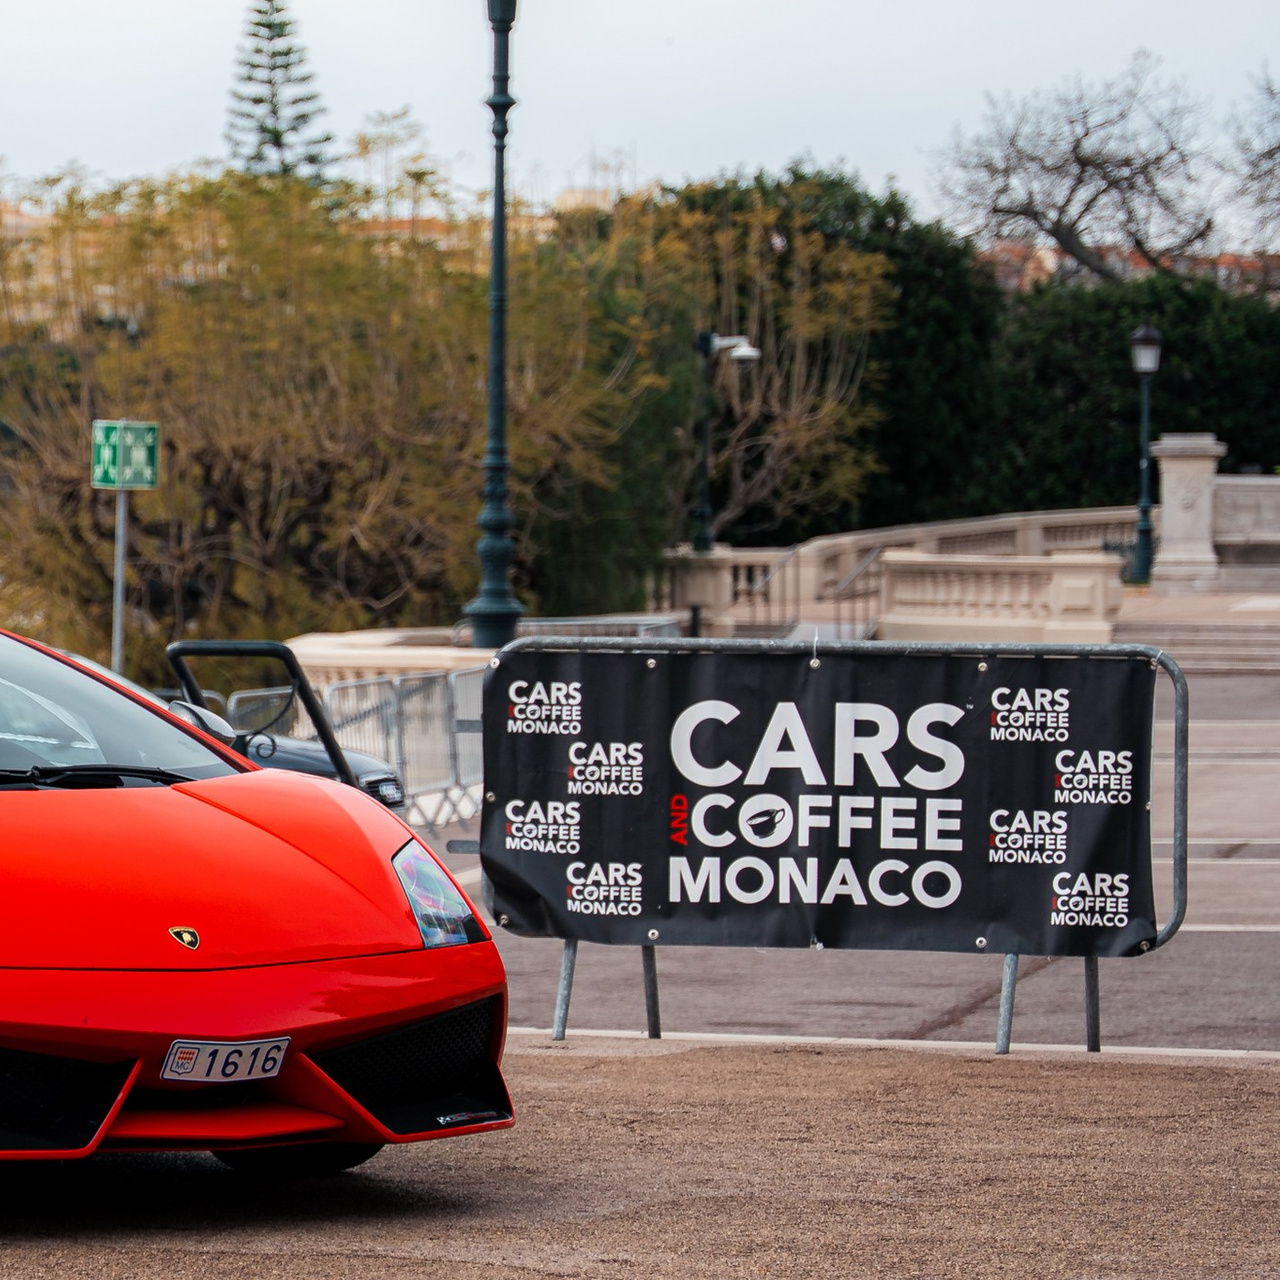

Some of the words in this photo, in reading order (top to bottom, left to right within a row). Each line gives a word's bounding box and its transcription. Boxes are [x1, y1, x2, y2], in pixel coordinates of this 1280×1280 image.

[508, 680, 582, 705] CARS
[991, 687, 1070, 711] CARS
[514, 705, 582, 720] COFFEE
[996, 711, 1069, 727] COFFEE
[507, 719, 581, 734] MONACO
[990, 727, 1069, 742] MONACO
[568, 741, 644, 765] CARS
[670, 699, 966, 791] CARS
[1055, 749, 1133, 774] CARS
[573, 765, 643, 781] COFFEE
[567, 781, 643, 795] MONACO
[1060, 774, 1132, 790] COFFEE
[1054, 789, 1132, 804] MONACO
[505, 799, 581, 824] CARS
[670, 793, 689, 846] AND
[691, 793, 963, 851] COFFEE
[989, 809, 1068, 834] CARS
[511, 823, 580, 840] COFFEE
[505, 837, 580, 854] MONACO
[995, 833, 1067, 850] COFFEE
[988, 849, 1066, 864] MONACO
[566, 861, 643, 886] CARS
[669, 856, 962, 909] MONACO
[1052, 871, 1130, 897] CARS
[572, 885, 642, 901] COFFEE
[566, 900, 642, 916] MONACO
[1057, 896, 1129, 913] COFFEE
[1051, 912, 1128, 928] MONACO
[174, 1061, 190, 1071] MC
[205, 1044, 282, 1078] 1616
